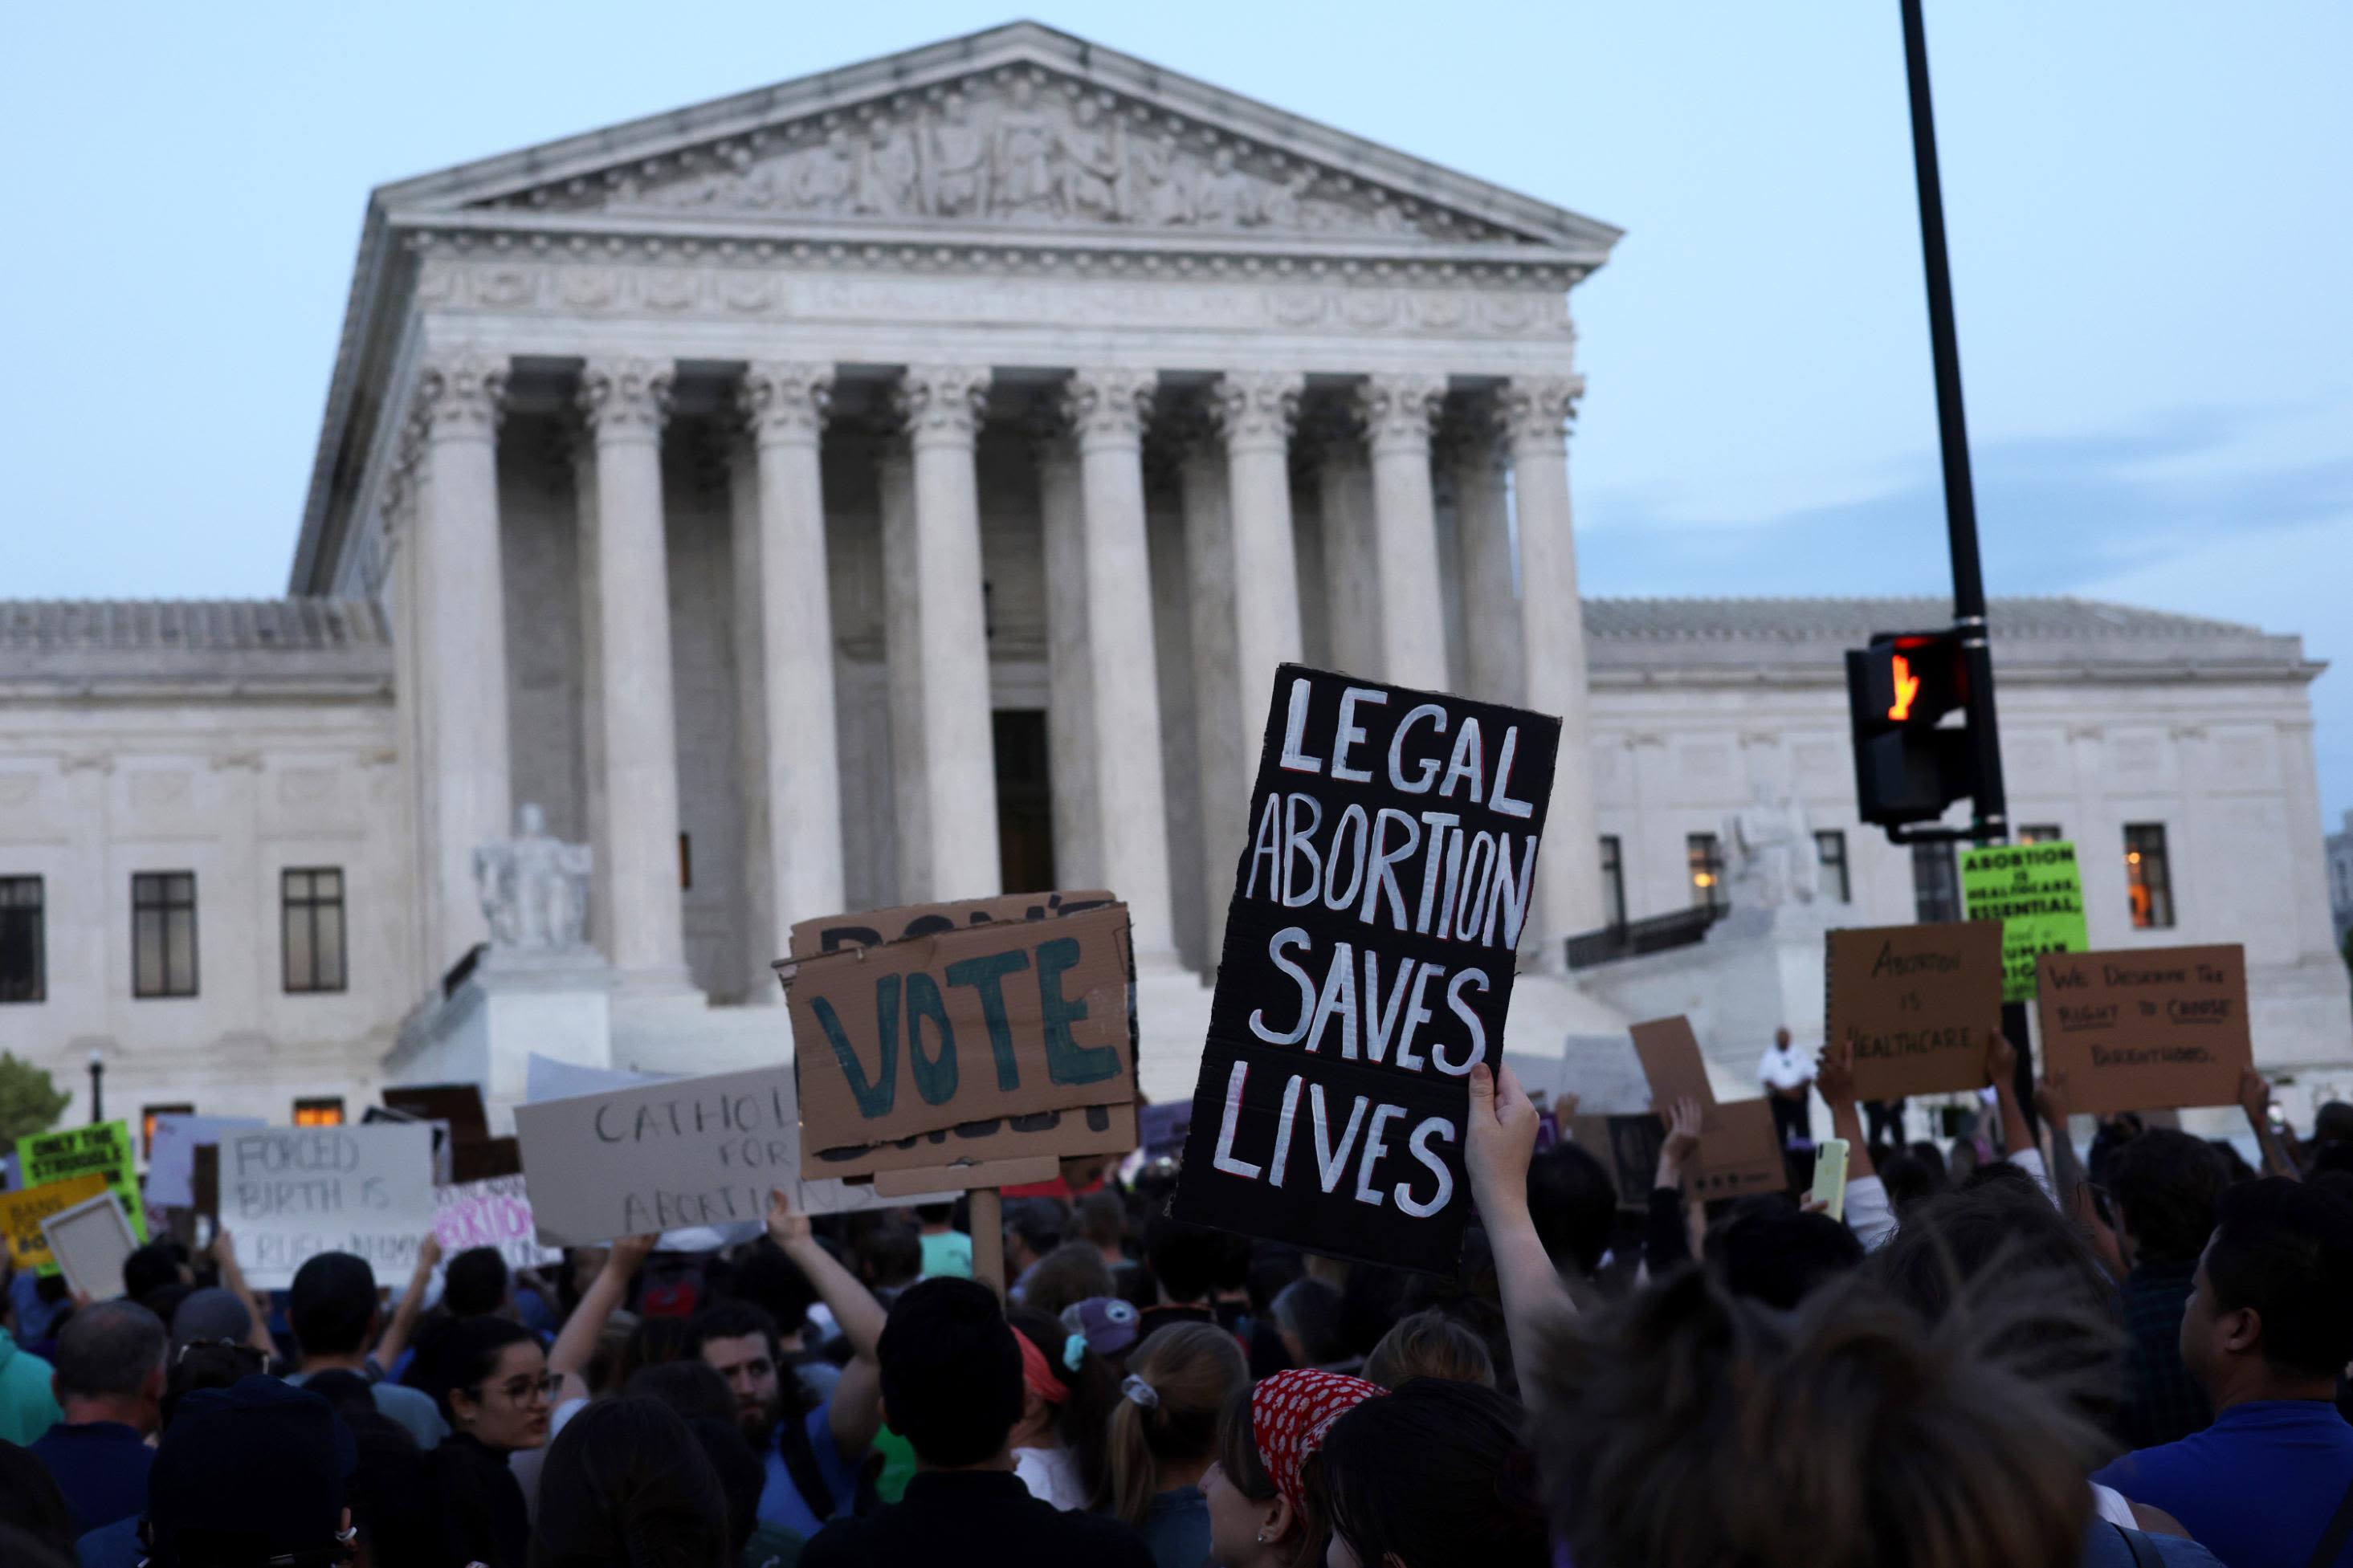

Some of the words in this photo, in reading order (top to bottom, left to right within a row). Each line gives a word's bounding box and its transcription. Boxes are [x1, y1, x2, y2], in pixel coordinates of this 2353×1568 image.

[1280, 678, 1533, 818] LEGAL
[1246, 792, 1537, 951] ABORTION
[1965, 848, 2074, 871] ABORTION
[2004, 942, 2068, 960] UMAN
[809, 937, 1123, 1119] VOTE
[1249, 927, 1490, 1077] SAVES
[595, 1086, 797, 1143] CATHOL
[1213, 1060, 1455, 1218] LIVES
[234, 1132, 361, 1176] FORCED
[720, 1137, 792, 1169] FOR
[236, 1179, 343, 1220] BIRTH
